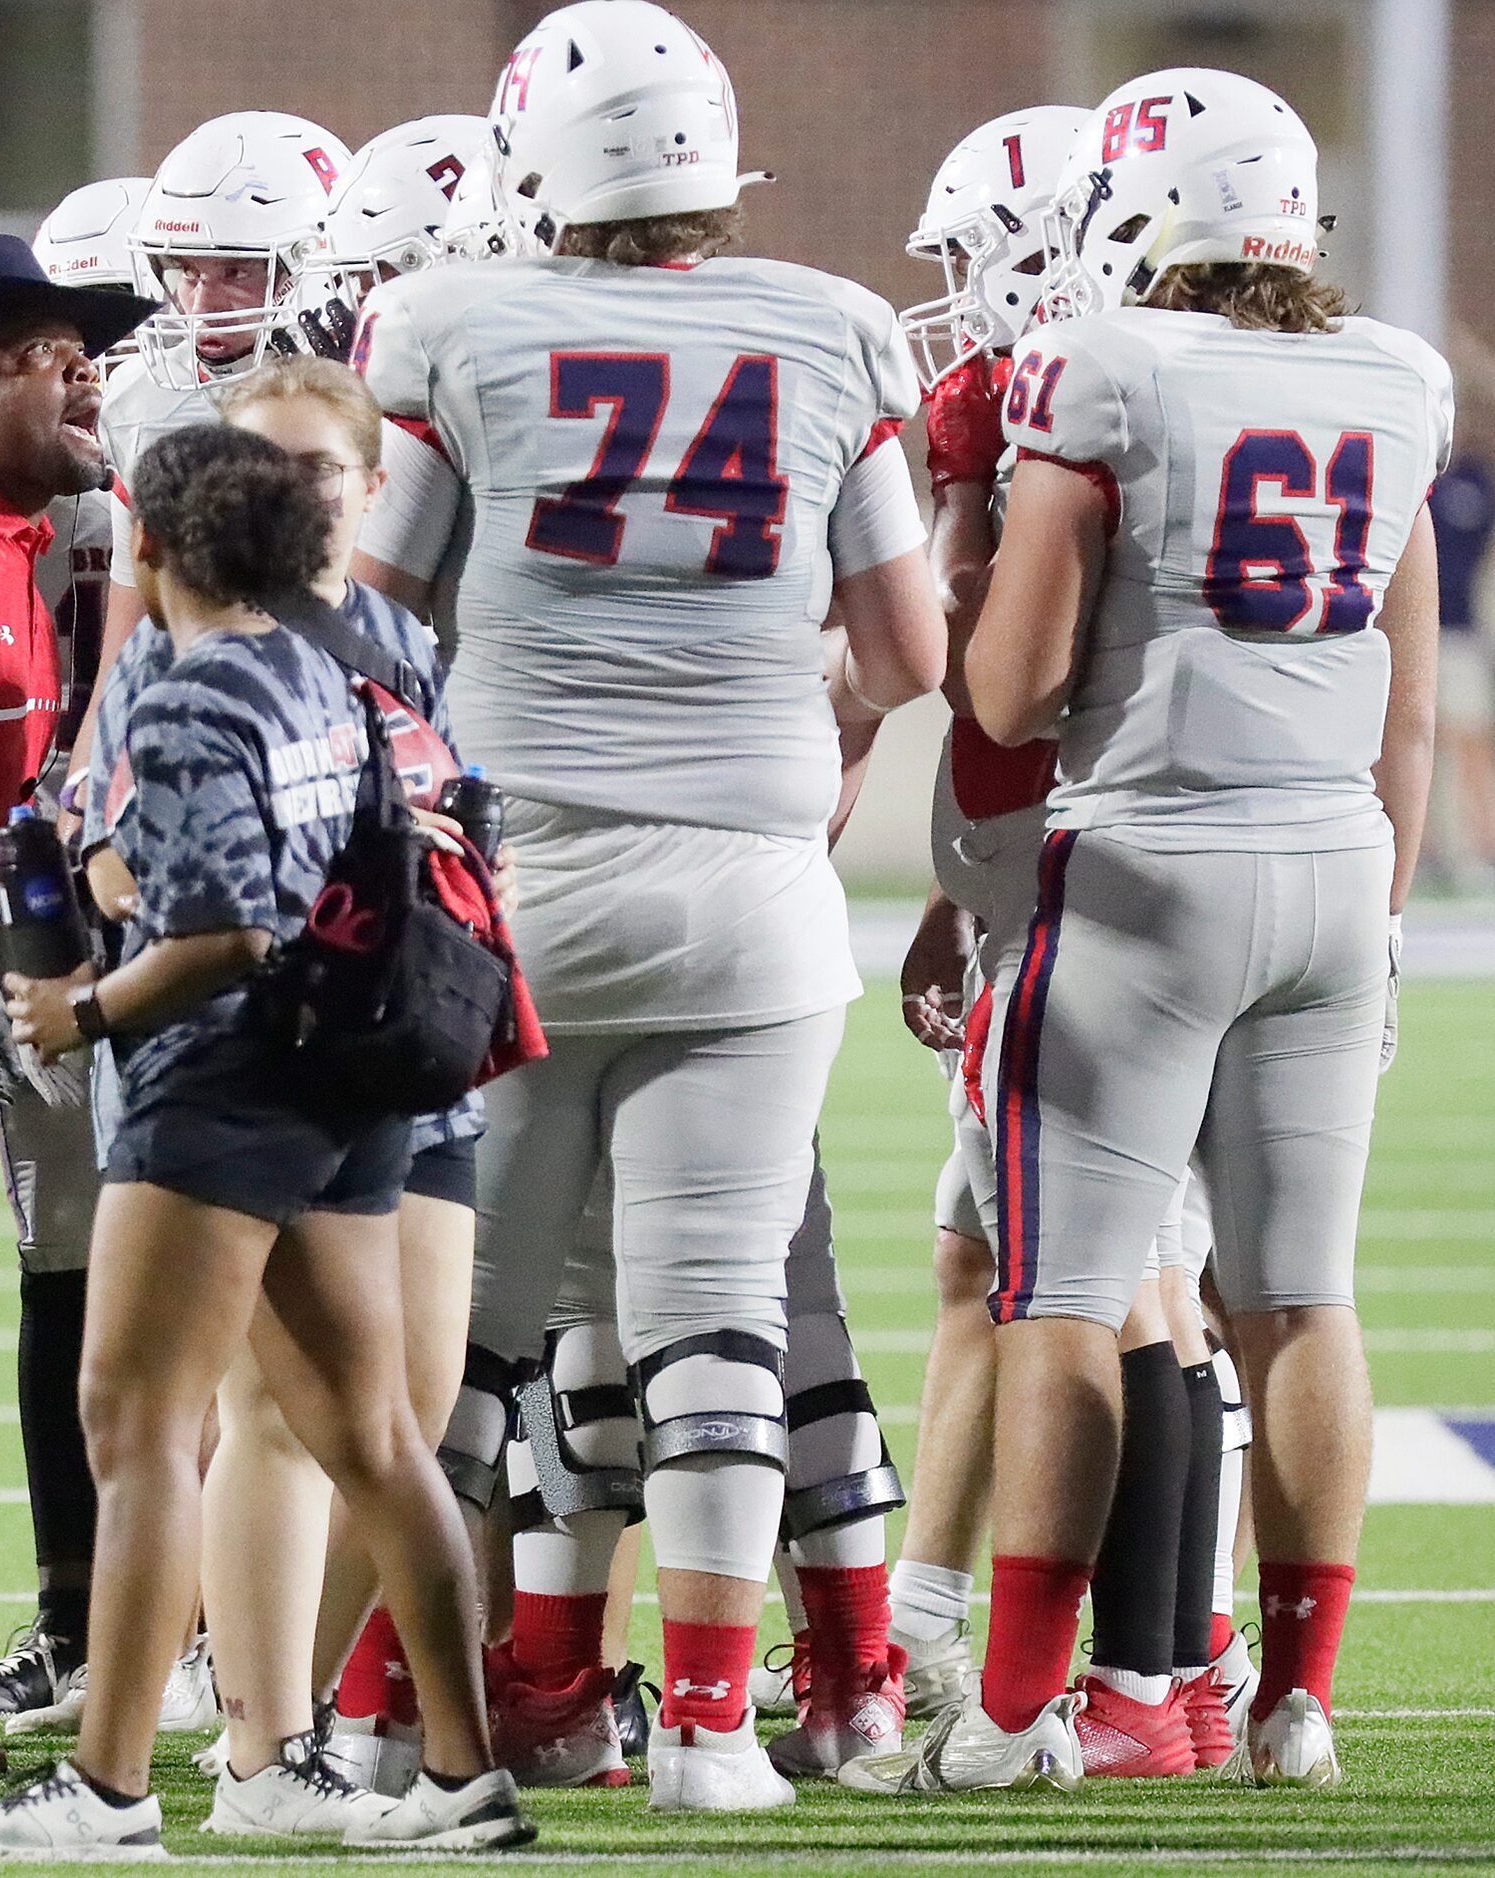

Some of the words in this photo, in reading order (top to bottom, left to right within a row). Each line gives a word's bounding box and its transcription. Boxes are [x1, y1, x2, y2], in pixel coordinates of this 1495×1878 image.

[662, 150, 699, 166] TPD
[1002, 133, 1025, 190] 1
[1102, 95, 1173, 165] 85
[154, 218, 199, 232] Riddell
[1279, 198, 1307, 216] TPD
[1006, 349, 1068, 434] 61
[525, 351, 791, 581] 74
[1202, 428, 1375, 635] 61
